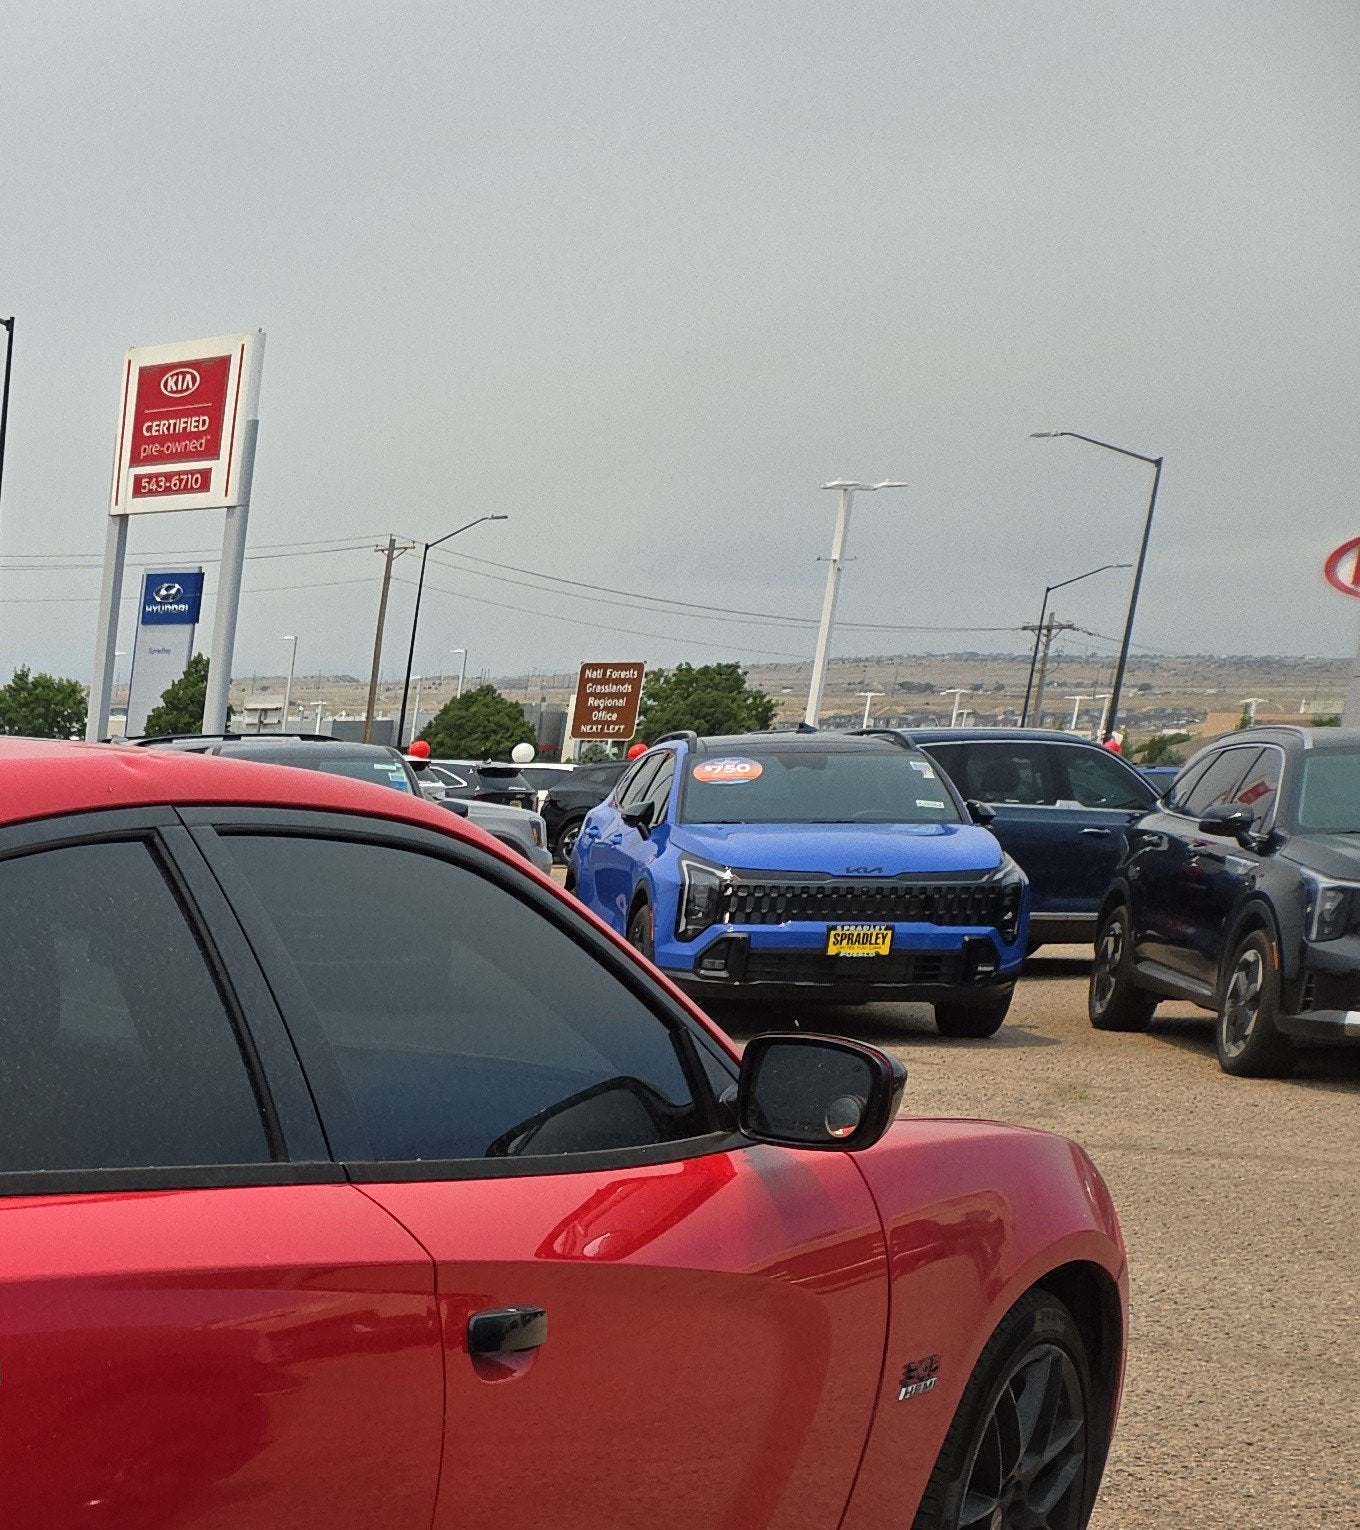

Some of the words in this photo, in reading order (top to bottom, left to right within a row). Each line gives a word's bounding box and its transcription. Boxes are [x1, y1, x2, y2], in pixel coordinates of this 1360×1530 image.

[166, 373, 194, 392] KIA
[142, 415, 210, 437] CERTIFIED
[140, 473, 202, 493] 543-6710
[605, 668, 638, 679] Forests
[586, 682, 632, 693] Grasslands
[587, 697, 627, 710] Regional
[592, 711, 618, 721] Office
[580, 724, 602, 733] NEXT
[604, 724, 626, 733] LEFT
[832, 932, 889, 946] SPRADLEY
